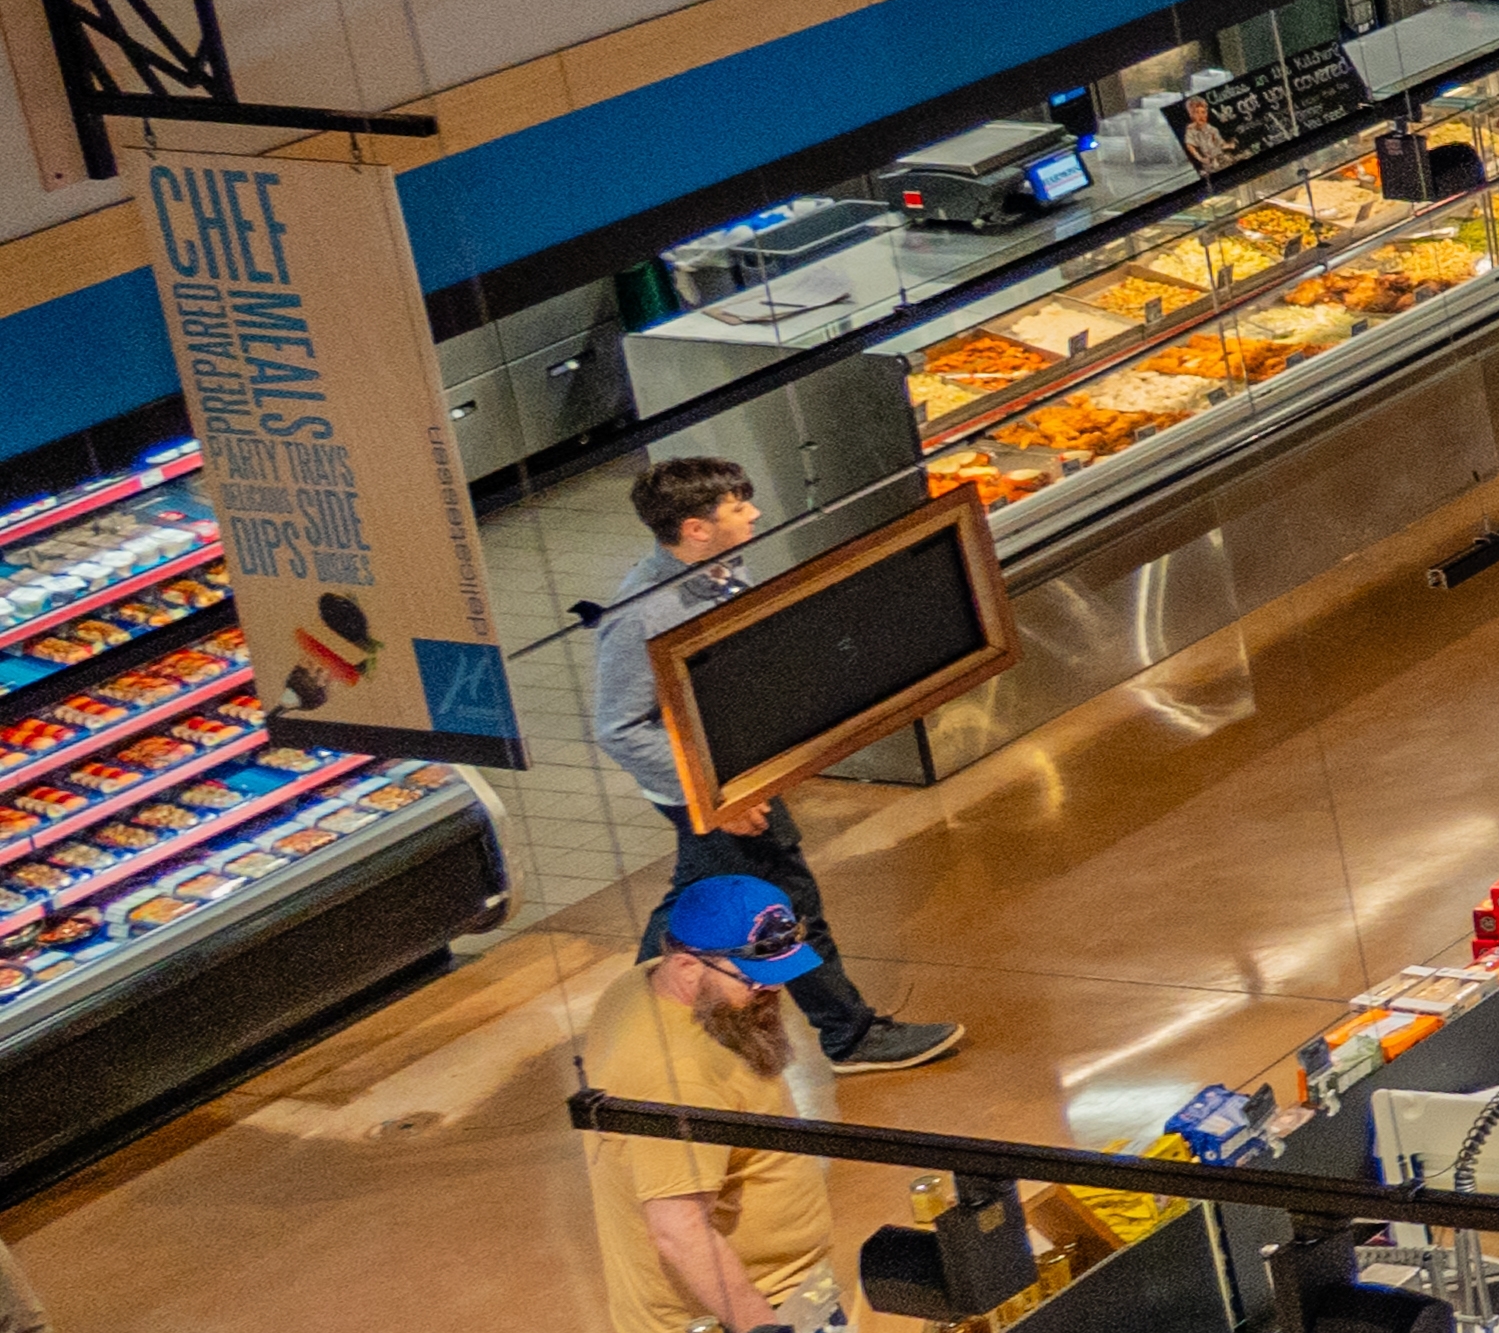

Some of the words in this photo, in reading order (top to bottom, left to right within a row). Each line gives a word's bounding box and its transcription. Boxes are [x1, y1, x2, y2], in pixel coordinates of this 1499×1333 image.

[1238, 92, 1260, 121] got
[1294, 61, 1350, 90] covered
[150, 166, 291, 285] CHEF
[172, 282, 253, 437] PREPARED
[227, 288, 334, 441] MEALS
[207, 436, 281, 483] PARTY
[283, 441, 356, 488] TRAYS
[230, 515, 308, 581] DIPS
[298, 485, 370, 552] SIDE
[426, 425, 491, 636] delicatessen
